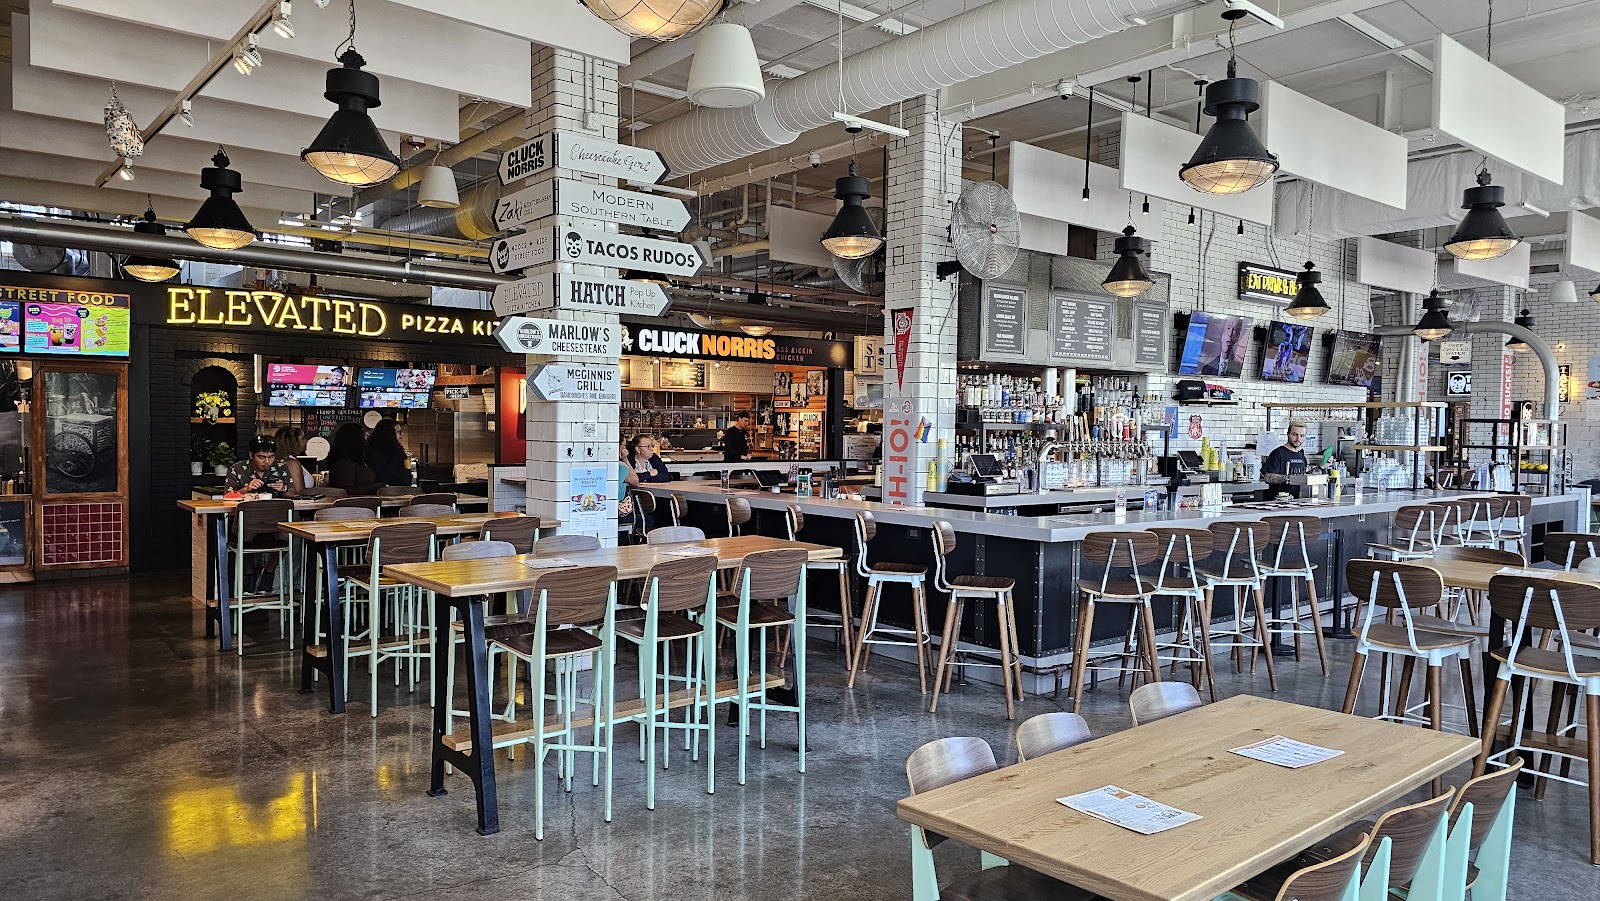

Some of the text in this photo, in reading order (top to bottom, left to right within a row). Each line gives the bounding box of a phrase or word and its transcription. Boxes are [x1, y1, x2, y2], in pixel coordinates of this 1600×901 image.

[507, 139, 545, 167] CLUCK
[570, 143, 651, 173] Cheesecake Girl
[507, 155, 545, 180] NORRIS
[592, 189, 655, 211] MODERN
[499, 200, 522, 223] Zaki
[571, 202, 674, 228] SOUTHERN TABLE
[531, 247, 545, 257] FOOD
[586, 239, 695, 268] TACOS RUDOS
[504, 281, 544, 304] ELEVATED
[630, 286, 657, 299] Pop Up
[1249, 273, 1262, 290] EAT
[67, 292, 115, 306] FOOD
[570, 280, 626, 307] HATCH
[630, 298, 656, 310] Kitchen
[167, 287, 388, 337] ELEVATED
[401, 314, 465, 334] PIZZA
[507, 299, 542, 312] PIZZA KITCHEN
[548, 323, 610, 343] MARLOW'S
[638, 328, 776, 360] CLUCK NORRIS
[552, 341, 607, 354] CHEESESTEAKS
[776, 346, 789, 354] ASS
[776, 353, 805, 362] CHICKEN
[577, 381, 605, 391] GRILL
[1504, 365, 1513, 405] BUCKS!
[1558, 366, 1569, 402] TACOS
